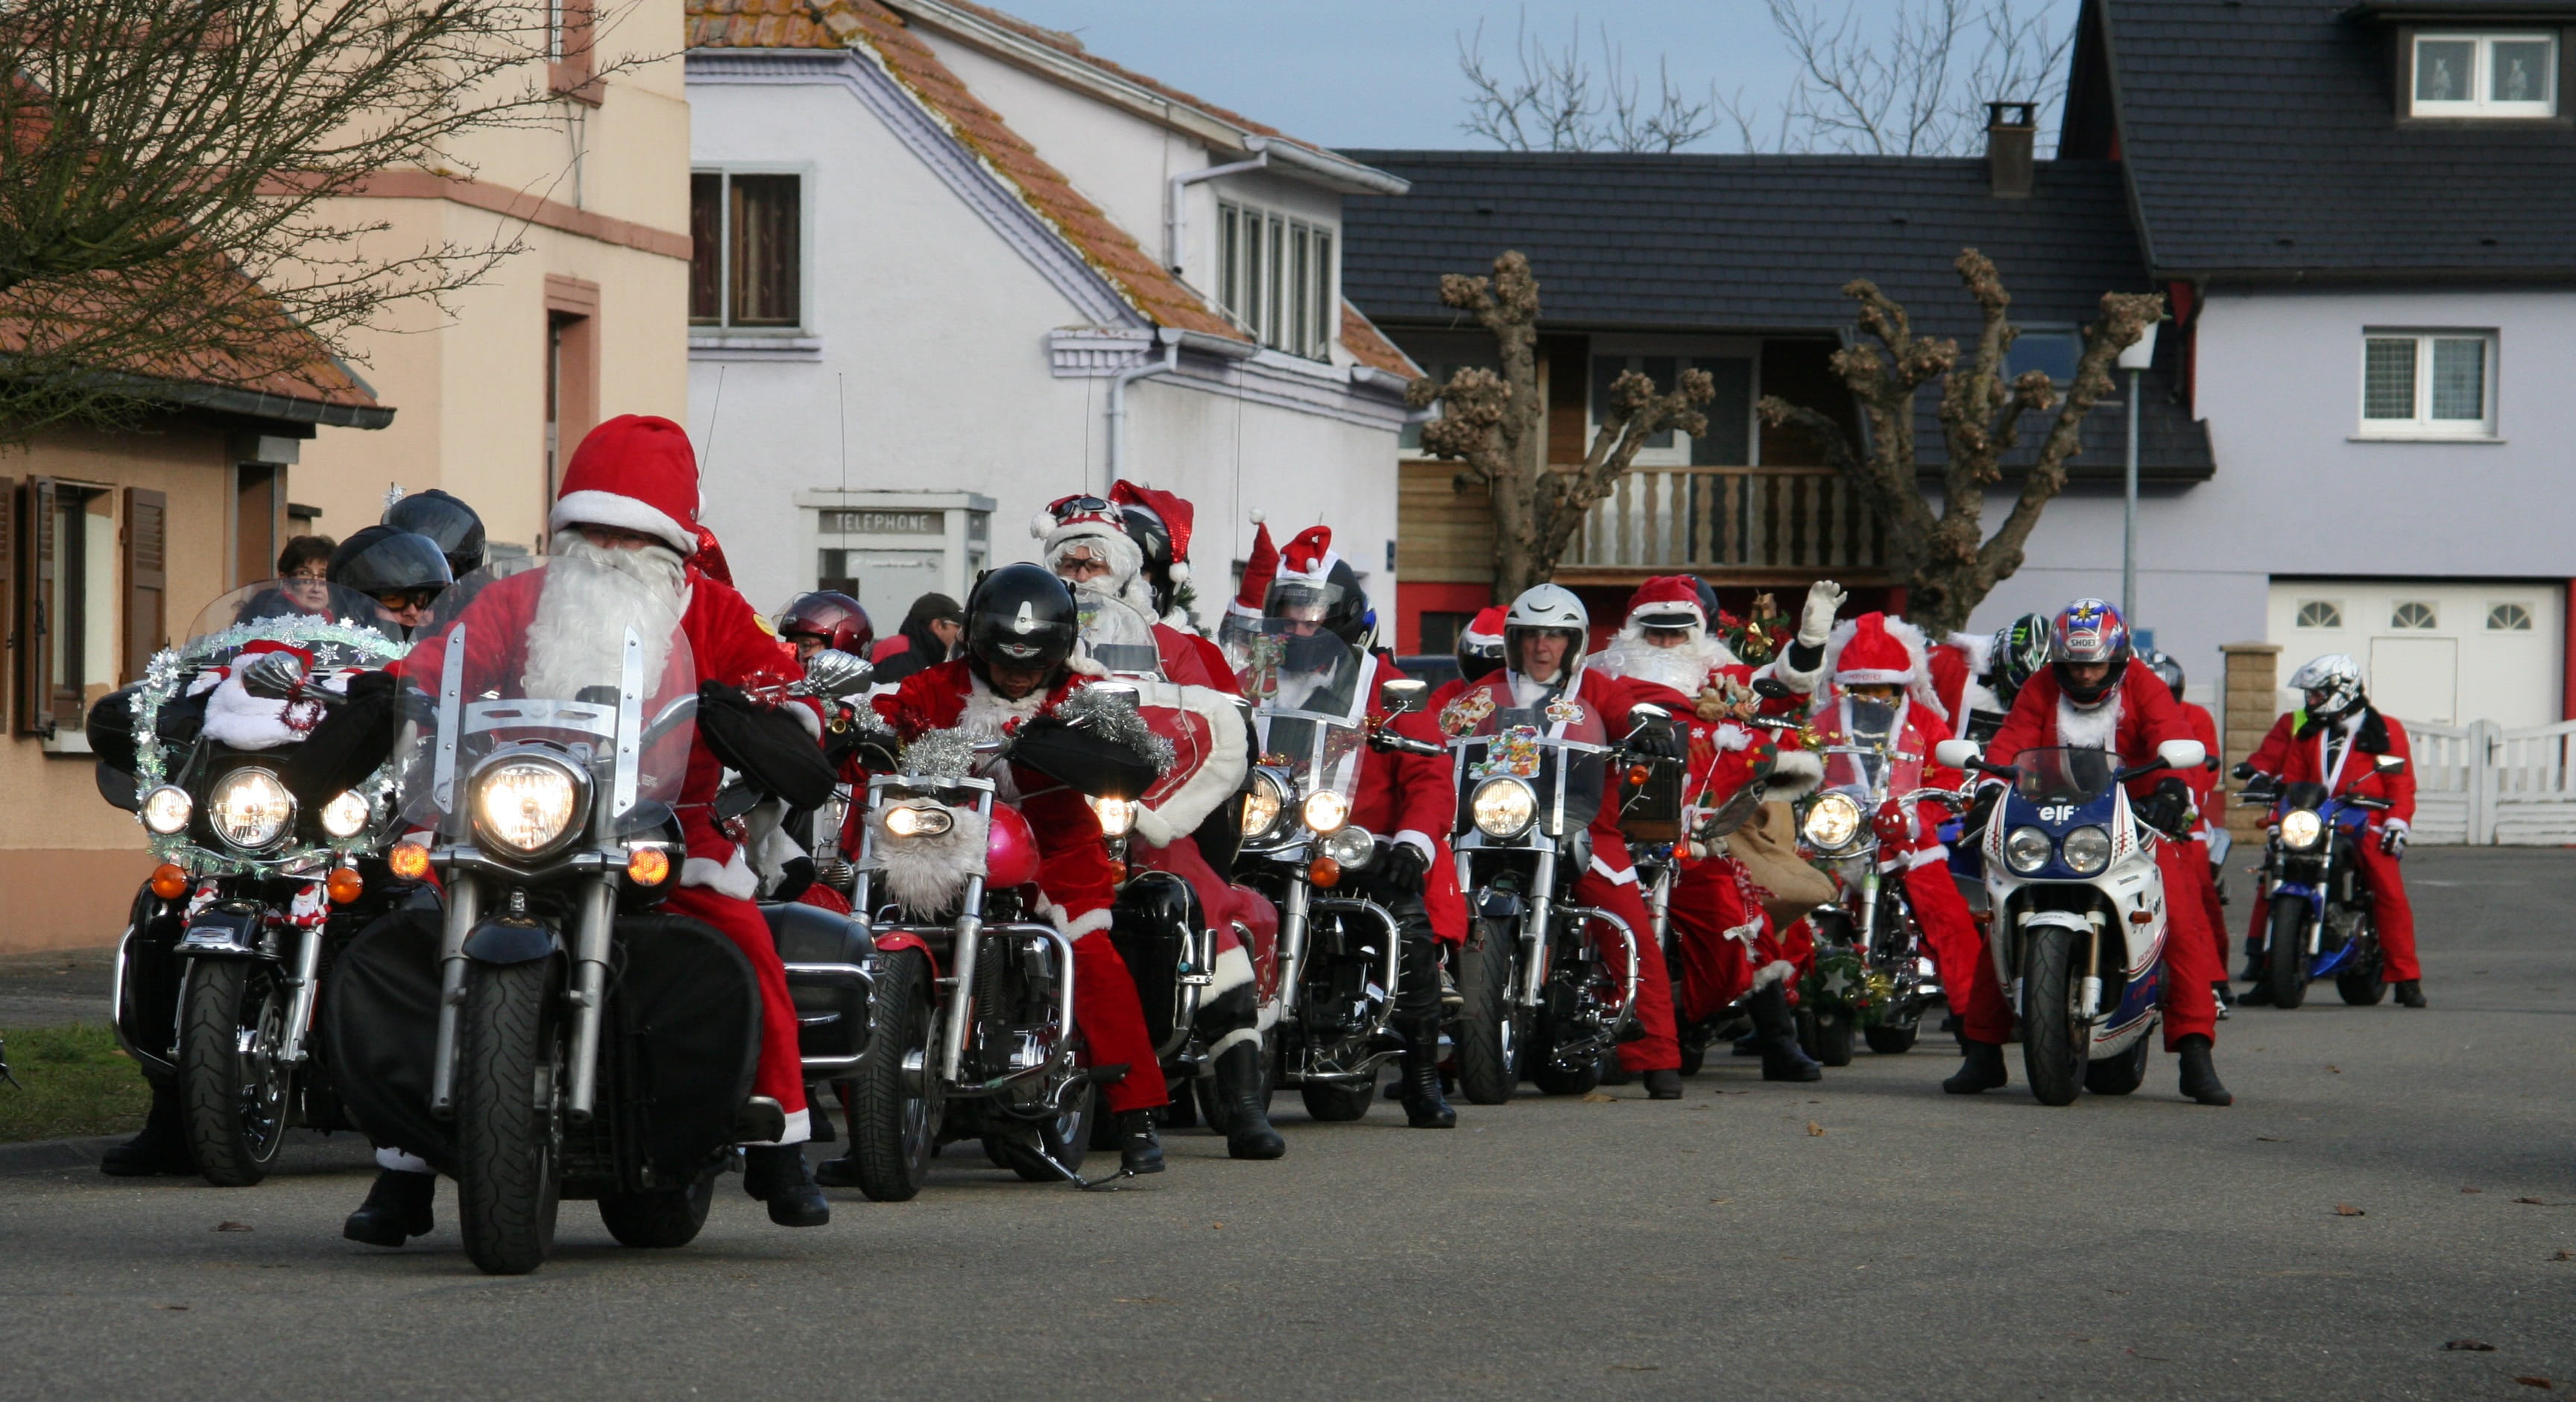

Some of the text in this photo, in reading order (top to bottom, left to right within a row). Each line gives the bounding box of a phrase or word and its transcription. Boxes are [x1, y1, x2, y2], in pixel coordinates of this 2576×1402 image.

[835, 513, 929, 531] TELEPHONE
[2071, 638, 2096, 647] SHOEI
[2039, 805, 2075, 821] elf
